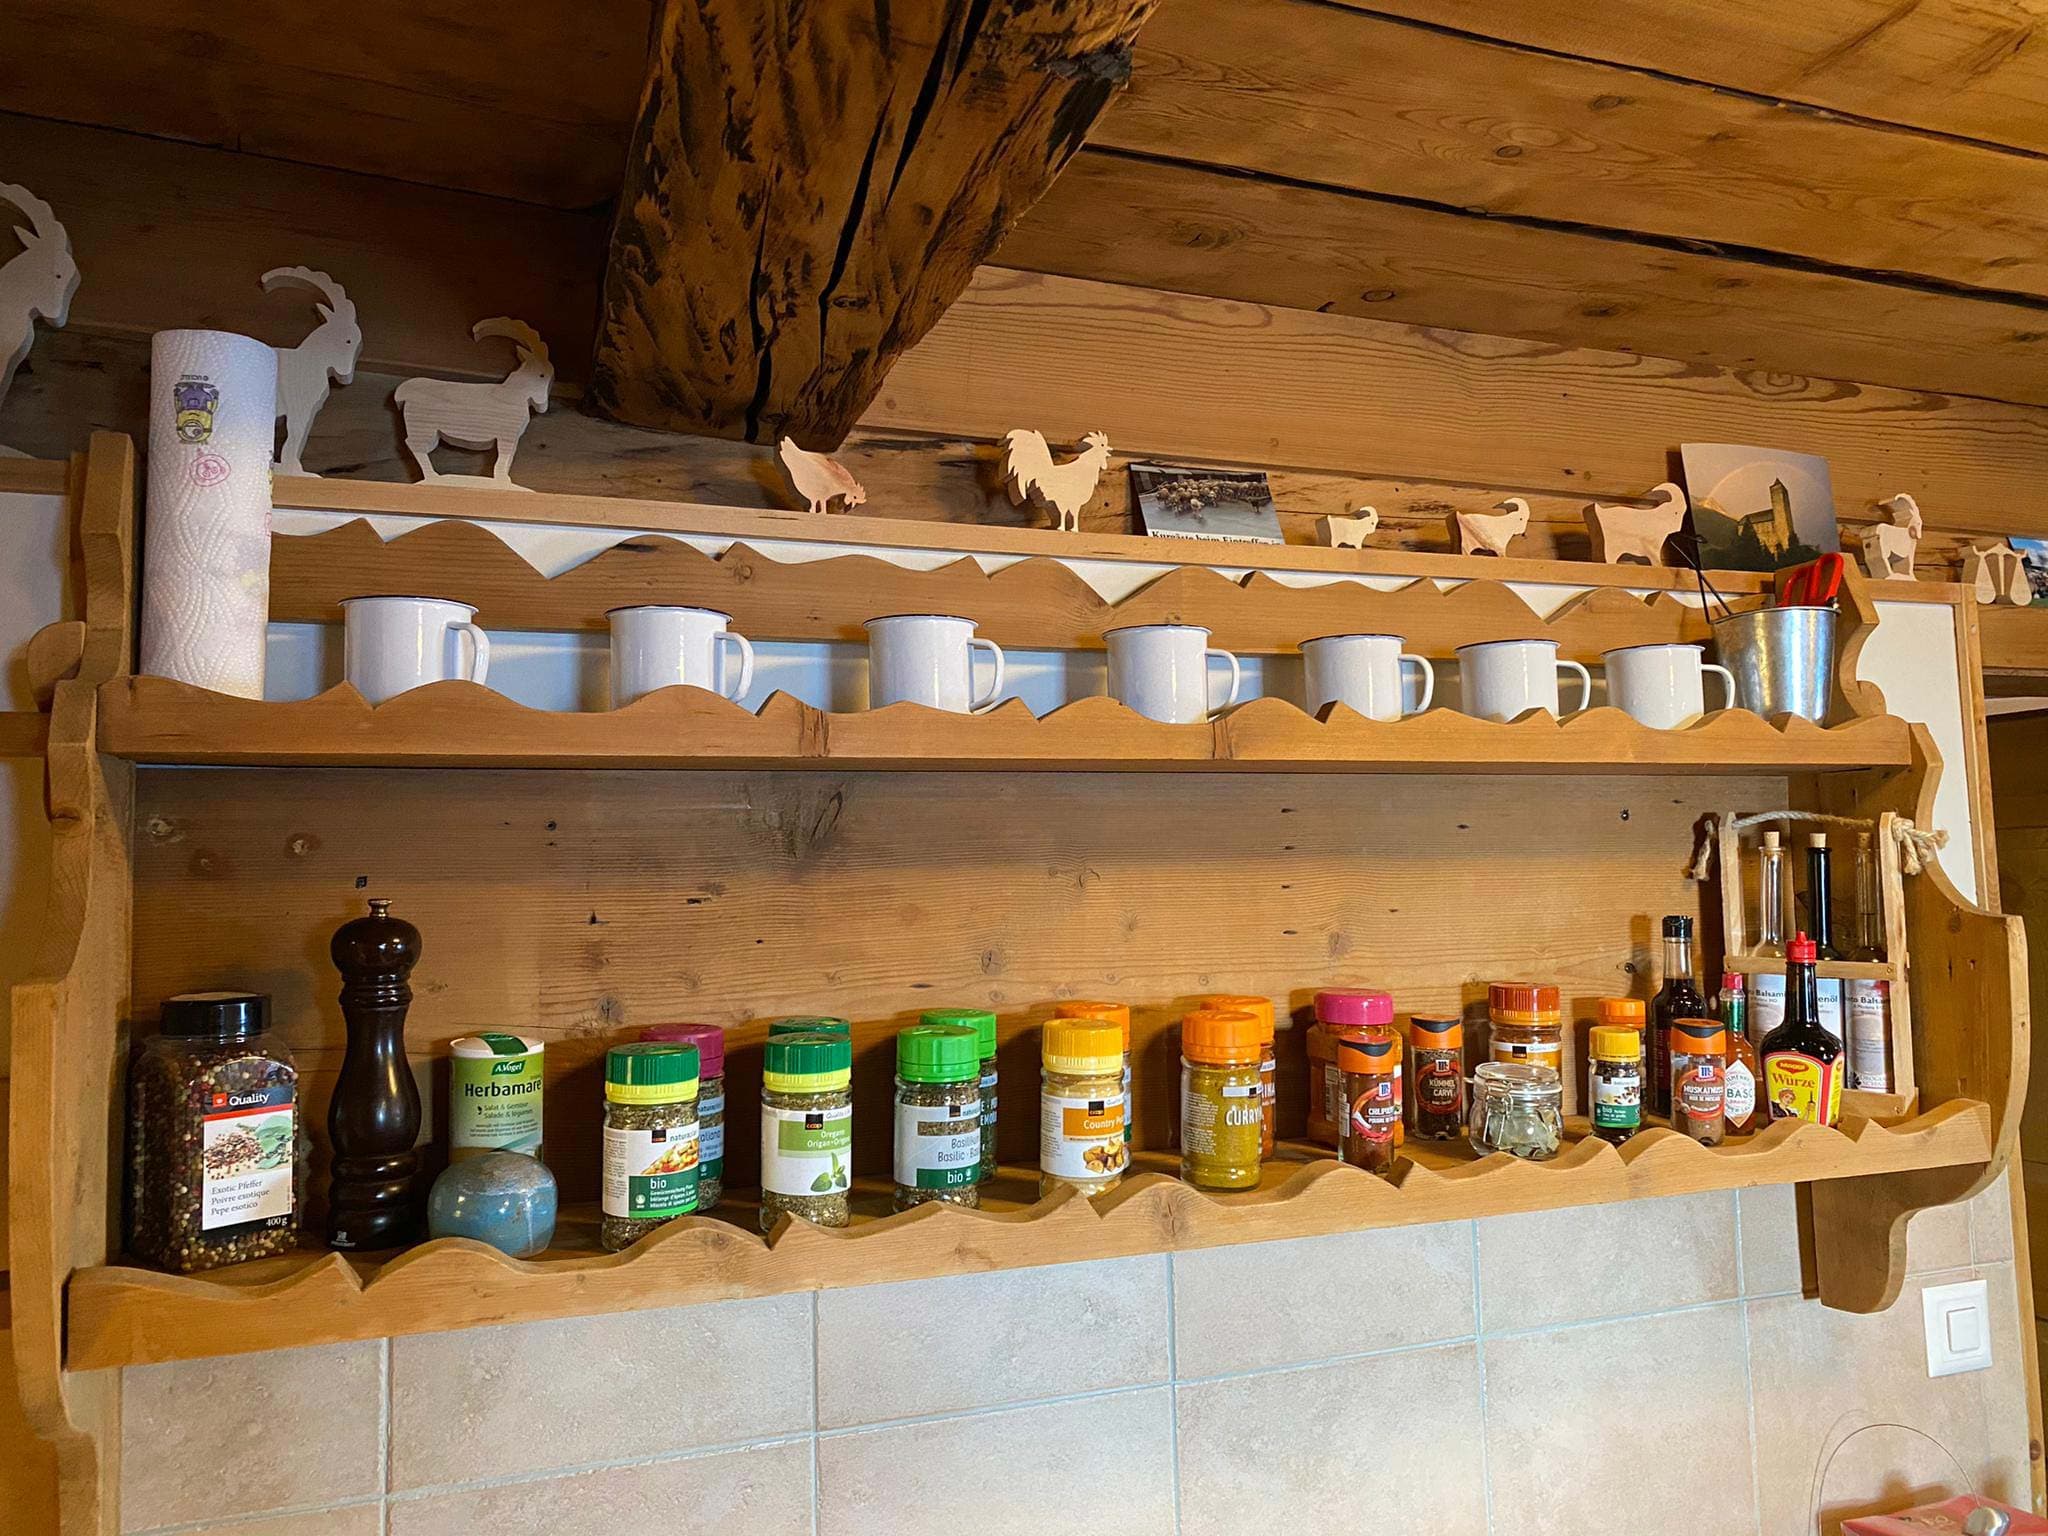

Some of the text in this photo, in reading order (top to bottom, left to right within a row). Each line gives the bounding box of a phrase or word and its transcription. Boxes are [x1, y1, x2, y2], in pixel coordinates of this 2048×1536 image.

[1816, 995, 1838, 1003] enöl
[464, 1080, 542, 1097] Herbamare
[229, 1092, 271, 1107] Quality
[1083, 1118, 1115, 1130] Country
[650, 1177, 667, 1190] bio
[947, 1170, 963, 1184] bio
[211, 1184, 237, 1195] Exotic
[210, 1189, 270, 1206] Poivre exotique
[210, 1200, 258, 1217] Pepe esotico
[266, 1216, 281, 1227] 400
